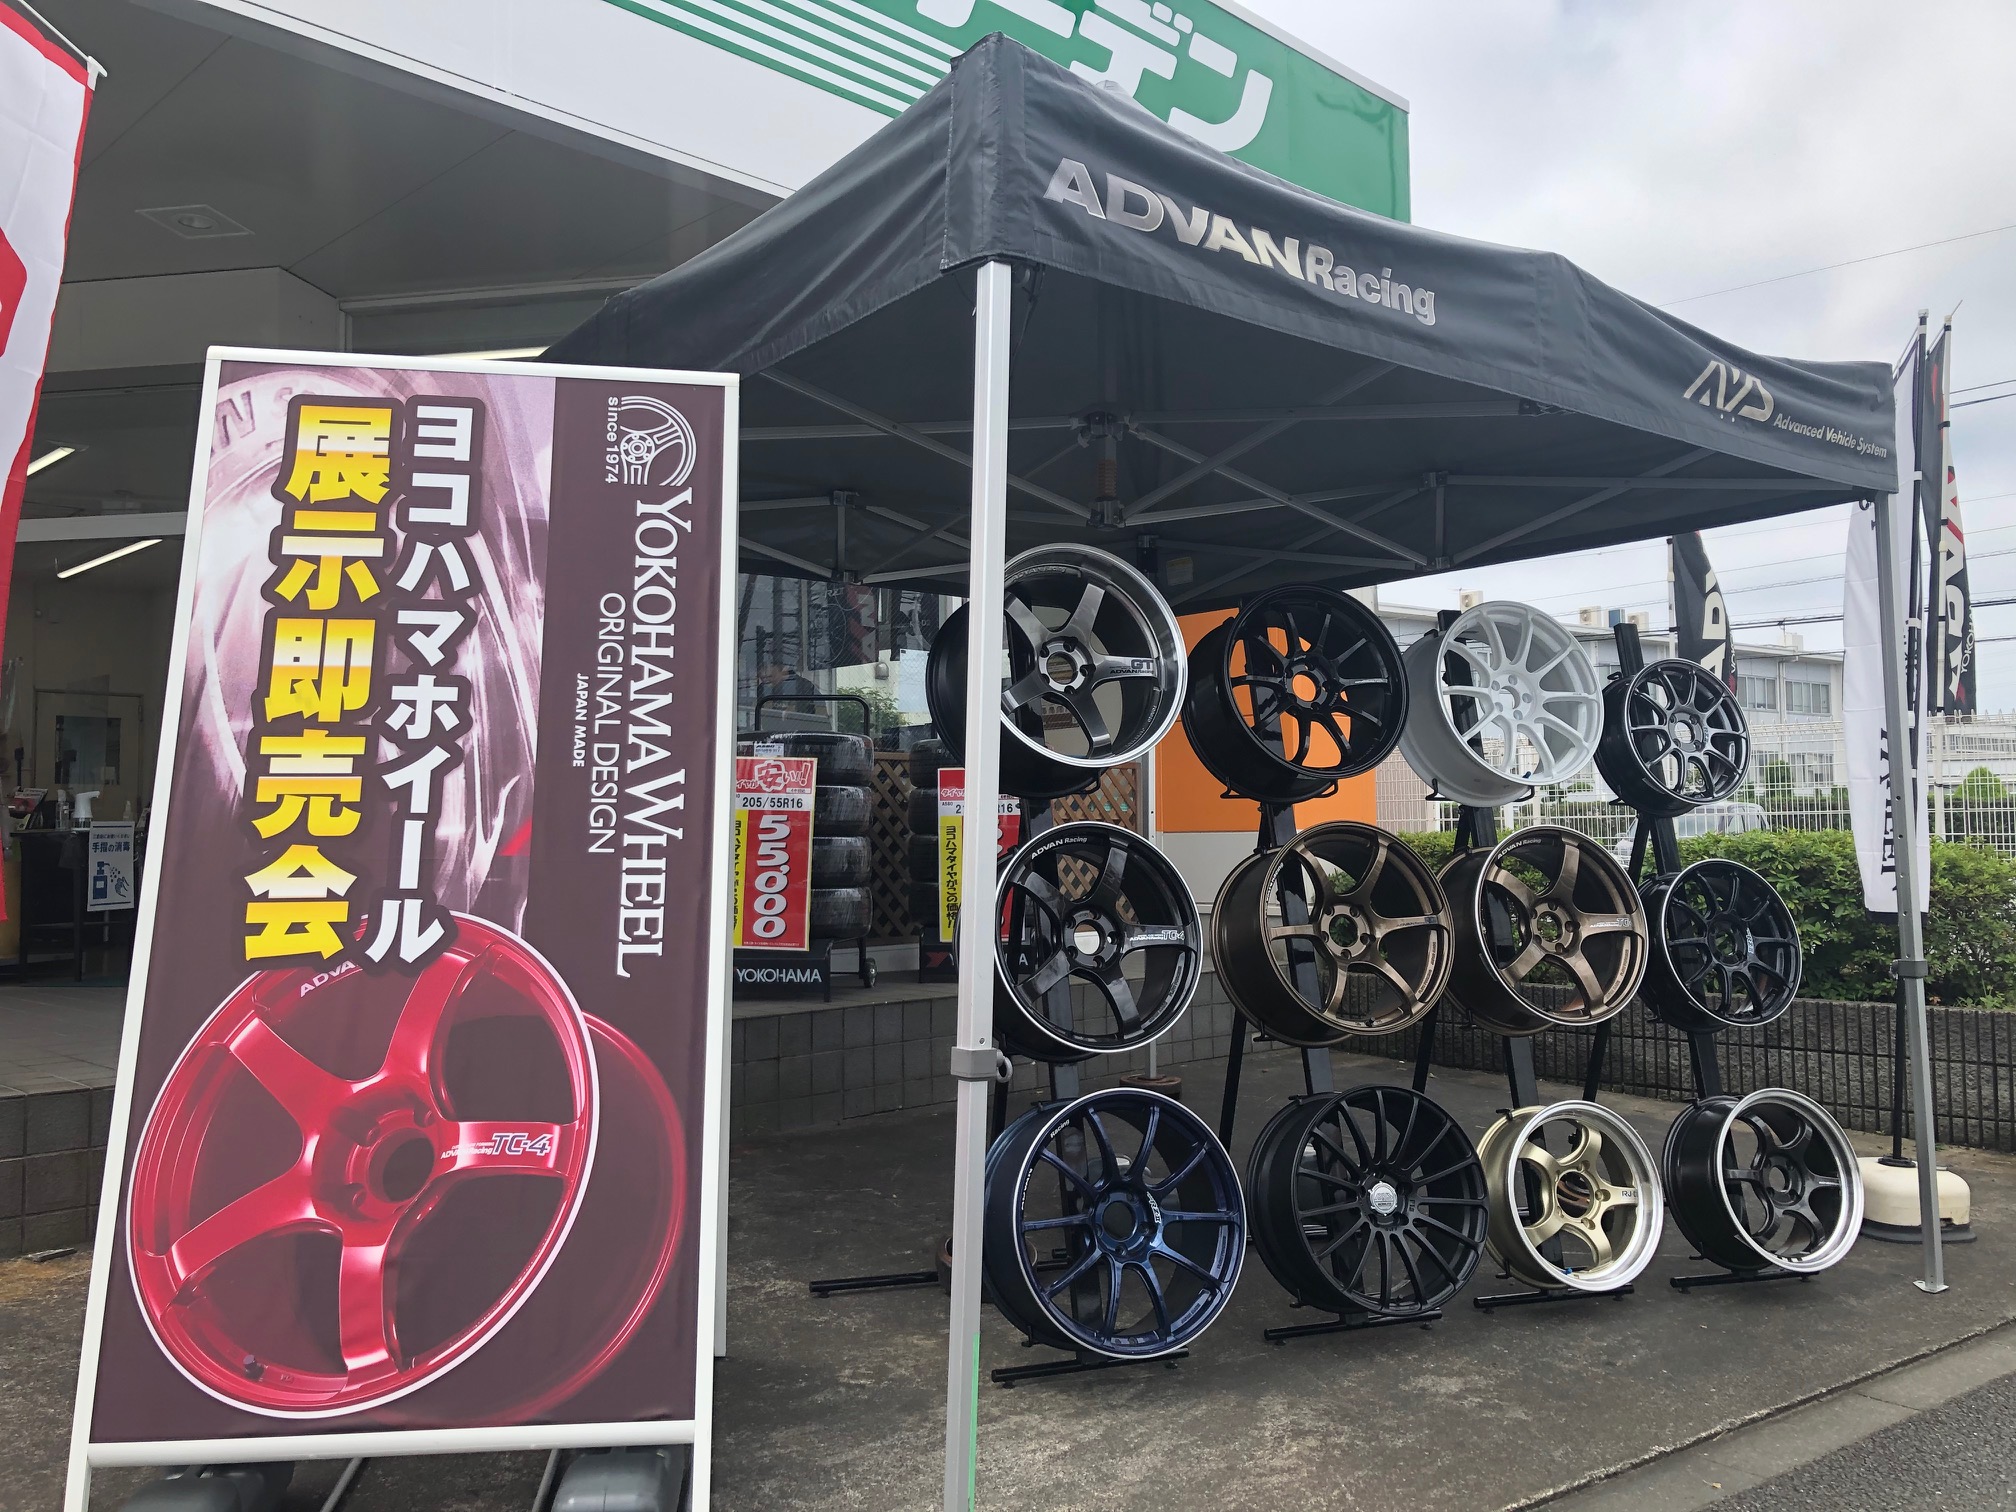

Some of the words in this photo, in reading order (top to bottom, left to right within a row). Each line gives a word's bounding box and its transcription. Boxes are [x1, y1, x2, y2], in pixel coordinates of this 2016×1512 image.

[1043, 157, 1305, 281] ADVAN
[1305, 243, 1437, 326] Racing
[606, 396, 620, 443] since
[1774, 412, 1825, 440] Advanced
[1826, 427, 1855, 448] Vehicle
[1856, 436, 1887, 459] System
[605, 445, 619, 485] 1974
[626, 487, 693, 774] YOKOHAMA
[245, 405, 393, 962] 展示即売会
[365, 406, 474, 965] ヨコハマホイール
[594, 592, 627, 735] ORIGINAL
[1131, 658, 1154, 670] GT
[575, 672, 590, 721] JAPAN
[572, 725, 588, 768] MADE
[588, 742, 621, 854] DESIGN
[742, 796, 803, 809] 205/55R16
[941, 788, 965, 798] タイヤ
[1031, 839, 1063, 860] ADVAN
[1064, 836, 1088, 845] Racing
[1497, 840, 1522, 860] ADVAN
[616, 768, 686, 979] WHEEL
[753, 814, 792, 939] 55,000
[300, 959, 358, 998] ADVA
[736, 968, 822, 983] YOKOHAMA
[492, 1132, 555, 1157] TC-4
[1050, 1118, 1070, 1139] Racing
